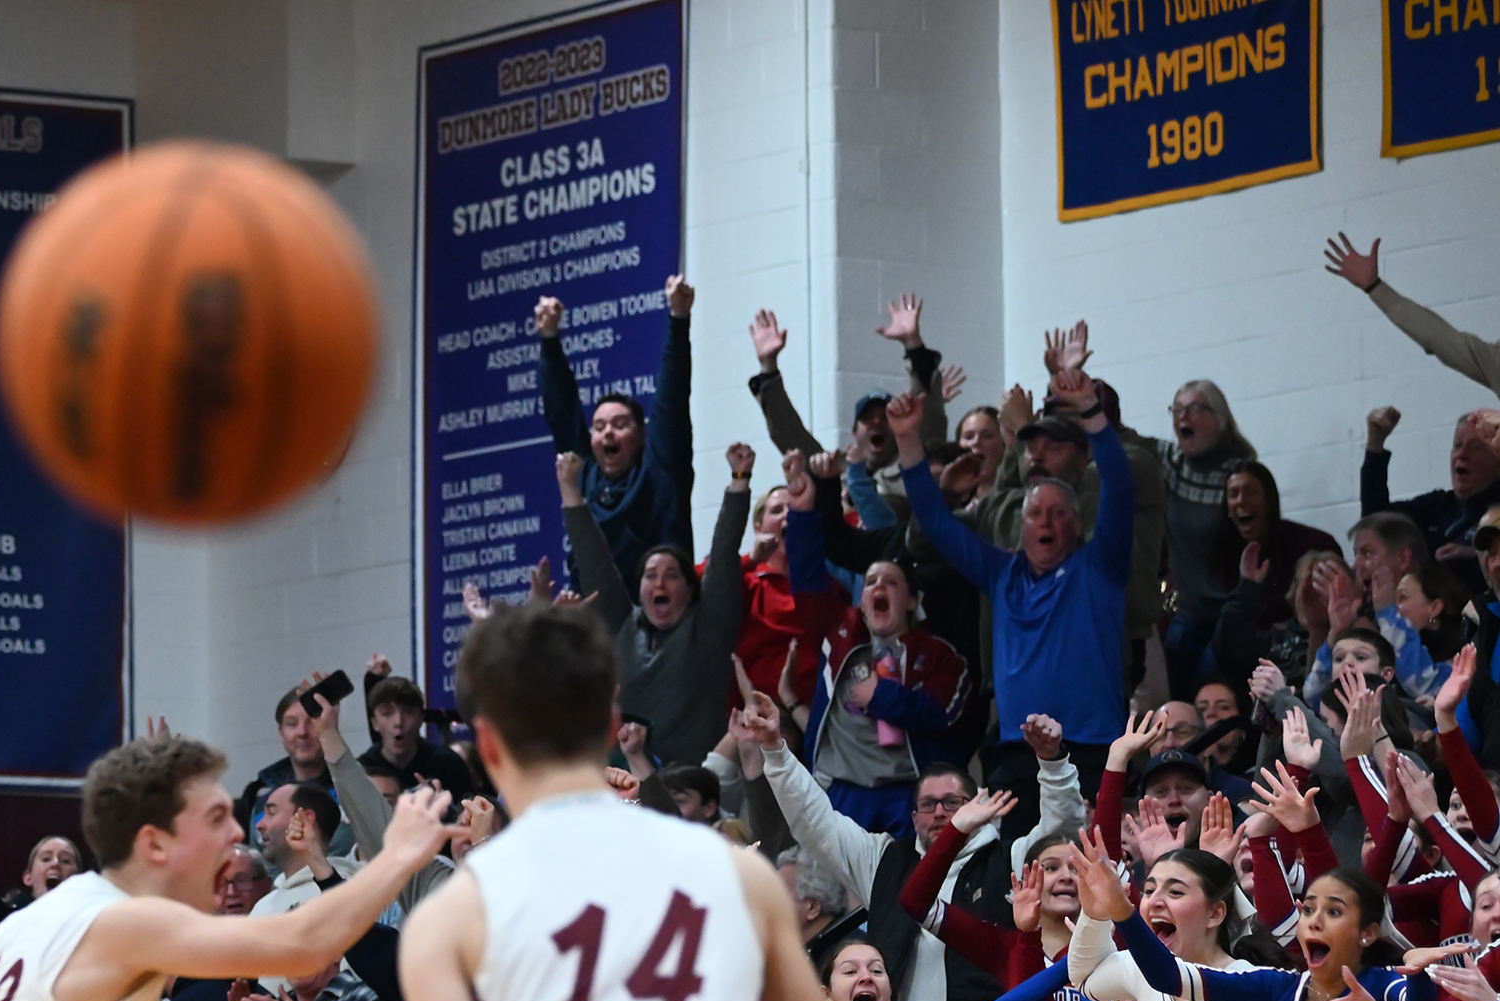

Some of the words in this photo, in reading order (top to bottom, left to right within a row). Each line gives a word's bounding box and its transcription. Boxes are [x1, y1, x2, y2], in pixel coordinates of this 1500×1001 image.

[499, 36, 606, 96] 2022-2023
[1084, 22, 1286, 110] CHAMPIONS
[438, 99, 538, 154] DUNMORE
[540, 86, 599, 130] LADY
[600, 63, 670, 116] BUCKS
[501, 146, 570, 187] CLASS
[577, 138, 604, 170] 3A
[1146, 110, 1225, 169] 1980
[454, 196, 518, 235] STATE
[523, 163, 656, 221] CHAMPIONS
[481, 240, 537, 270] DISTRICT
[540, 240, 547, 257] 2
[549, 221, 625, 255] CHAMPIONS
[498, 267, 551, 294] DIVISION
[564, 246, 640, 280] CHAMPIONS
[472, 321, 517, 347] COACH
